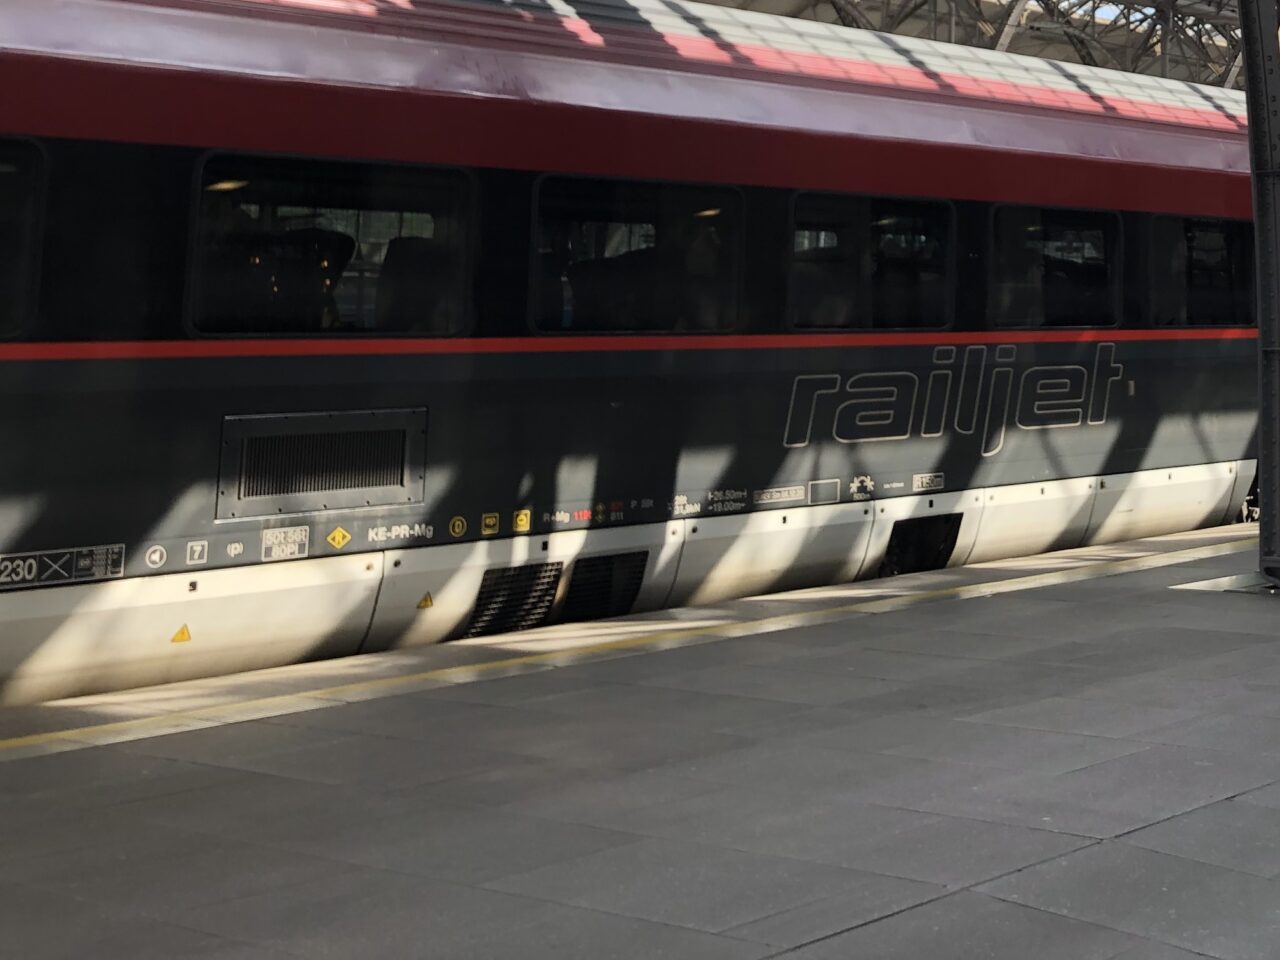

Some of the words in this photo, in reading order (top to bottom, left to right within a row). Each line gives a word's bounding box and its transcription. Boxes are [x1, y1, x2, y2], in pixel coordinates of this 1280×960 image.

[783, 341, 1124, 457] railjet
[367, 524, 434, 542] KE-PR-Mg
[192, 546, 203, 559] 7
[0, 558, 37, 582] 230
